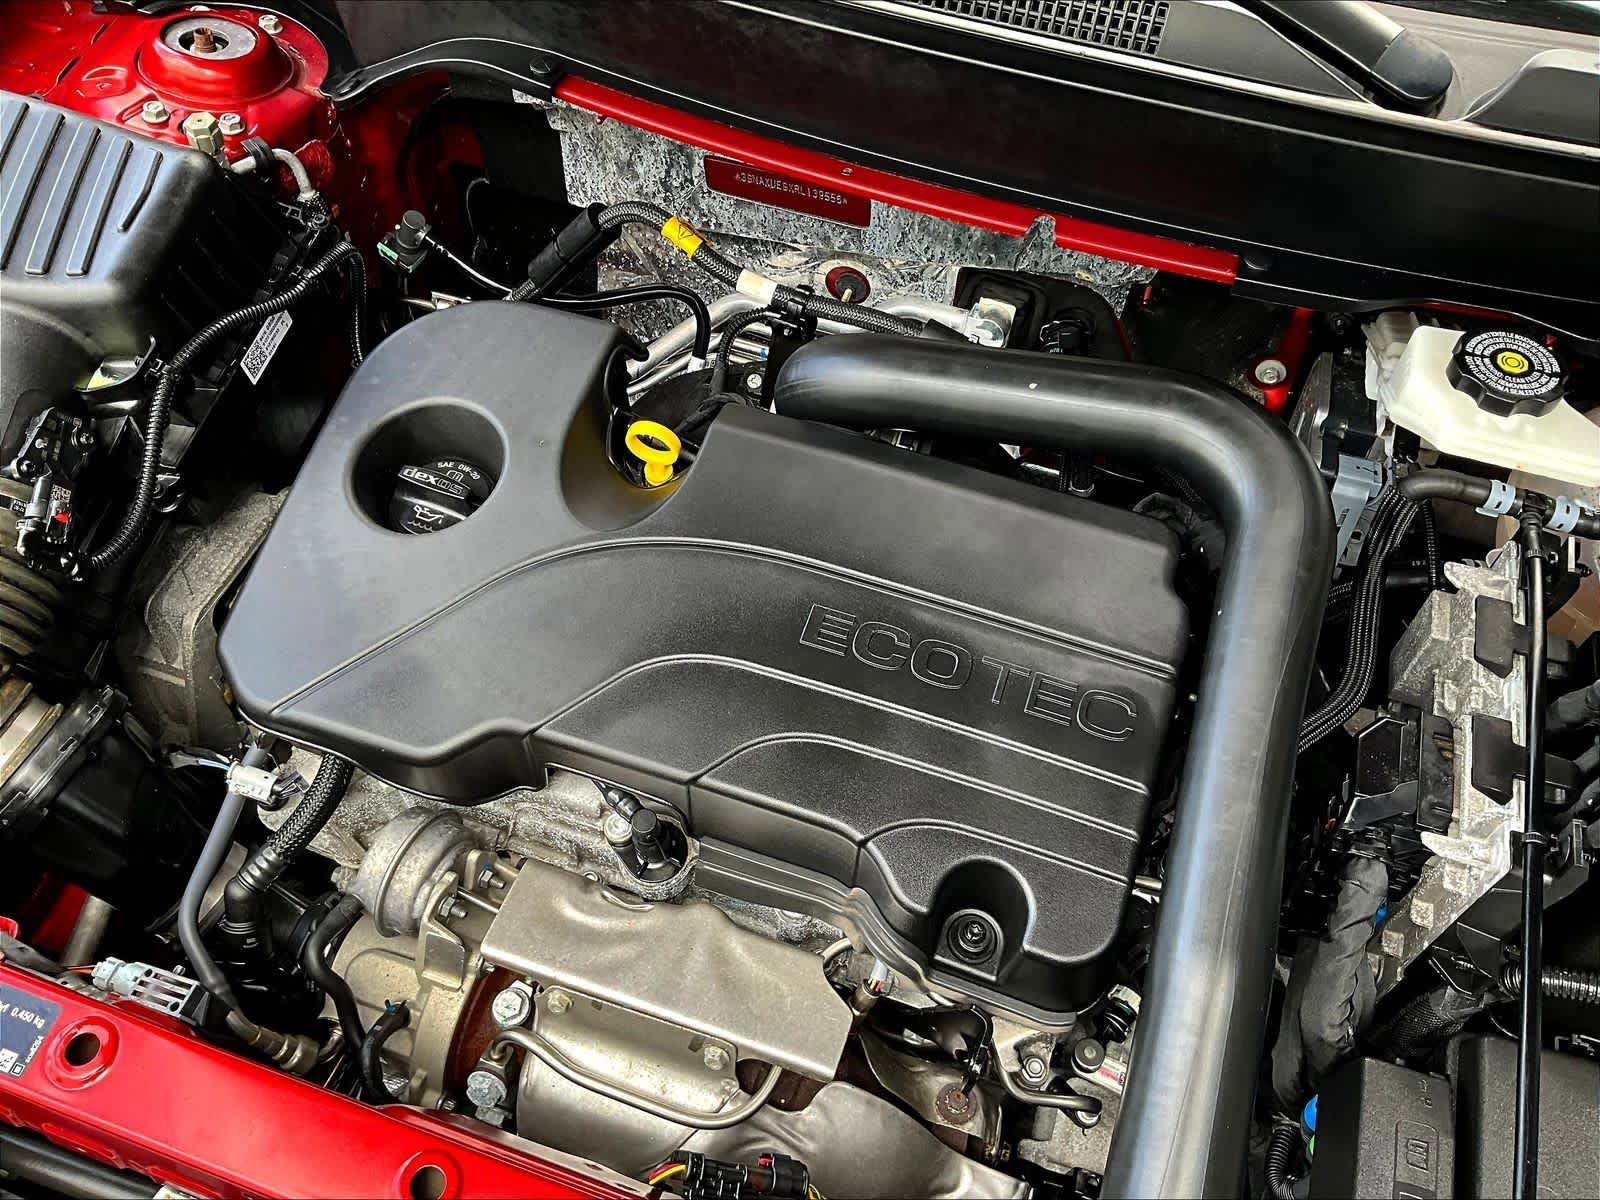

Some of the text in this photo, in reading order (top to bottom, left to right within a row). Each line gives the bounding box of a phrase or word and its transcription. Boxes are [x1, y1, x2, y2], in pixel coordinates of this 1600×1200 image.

[403, 468, 463, 494] dexos
[458, 464, 481, 480] 0W-20
[799, 603, 1137, 743] ECOTEC
[11, 1007, 46, 1029] 0.450 kg
